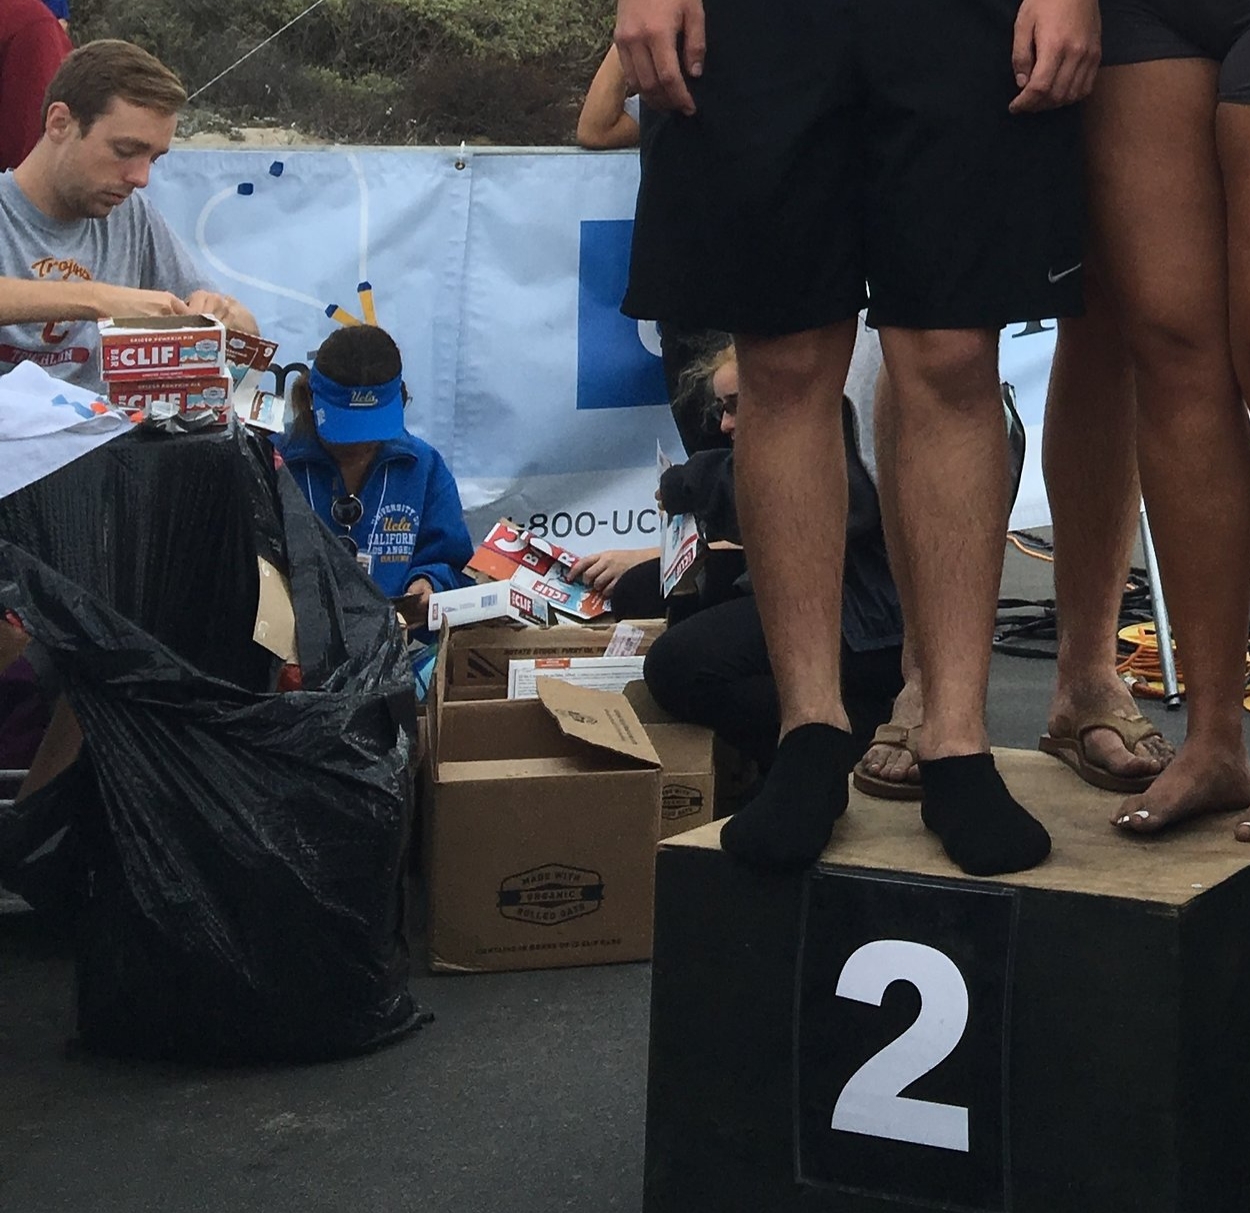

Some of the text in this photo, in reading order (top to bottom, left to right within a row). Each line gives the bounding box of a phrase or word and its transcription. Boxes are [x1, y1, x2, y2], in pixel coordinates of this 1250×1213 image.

[110, 348, 119, 368] BAR
[120, 346, 174, 367] CLIF
[350, 390, 378, 405] Ucla
[383, 516, 412, 532] Ucla
[515, 593, 533, 613] CLIF
[522, 871, 581, 885] MADE WITH
[526, 890, 576, 901] ORGANIC
[516, 903, 585, 920] ROLLED OATS
[832, 939, 969, 1152] 2
